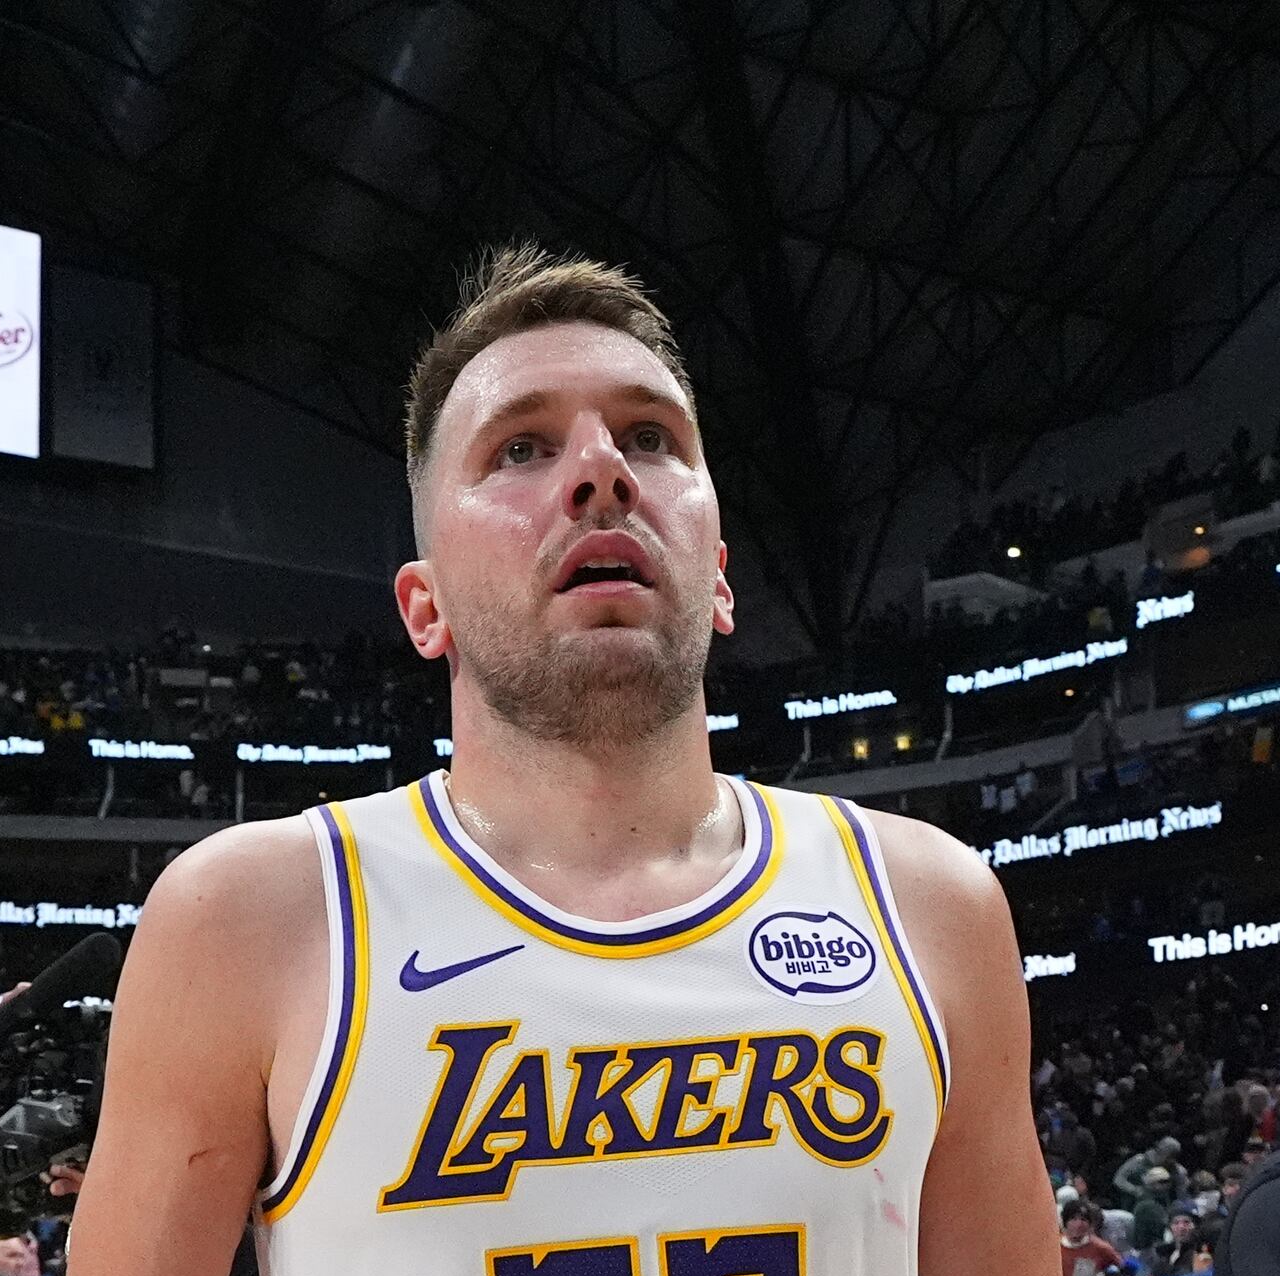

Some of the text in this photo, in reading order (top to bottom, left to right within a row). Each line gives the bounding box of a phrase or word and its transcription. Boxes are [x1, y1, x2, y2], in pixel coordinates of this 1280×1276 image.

[784, 690, 897, 720] This is Home.
[993, 833, 1061, 867] Dallas
[1064, 818, 1159, 856] Morning
[1161, 802, 1221, 837] News
[760, 932, 867, 967] bibigo
[1148, 933, 1207, 962] This
[1208, 930, 1232, 955] is
[785, 961, 832, 975] 비비고
[377, 1020, 894, 1213] LAKERS
